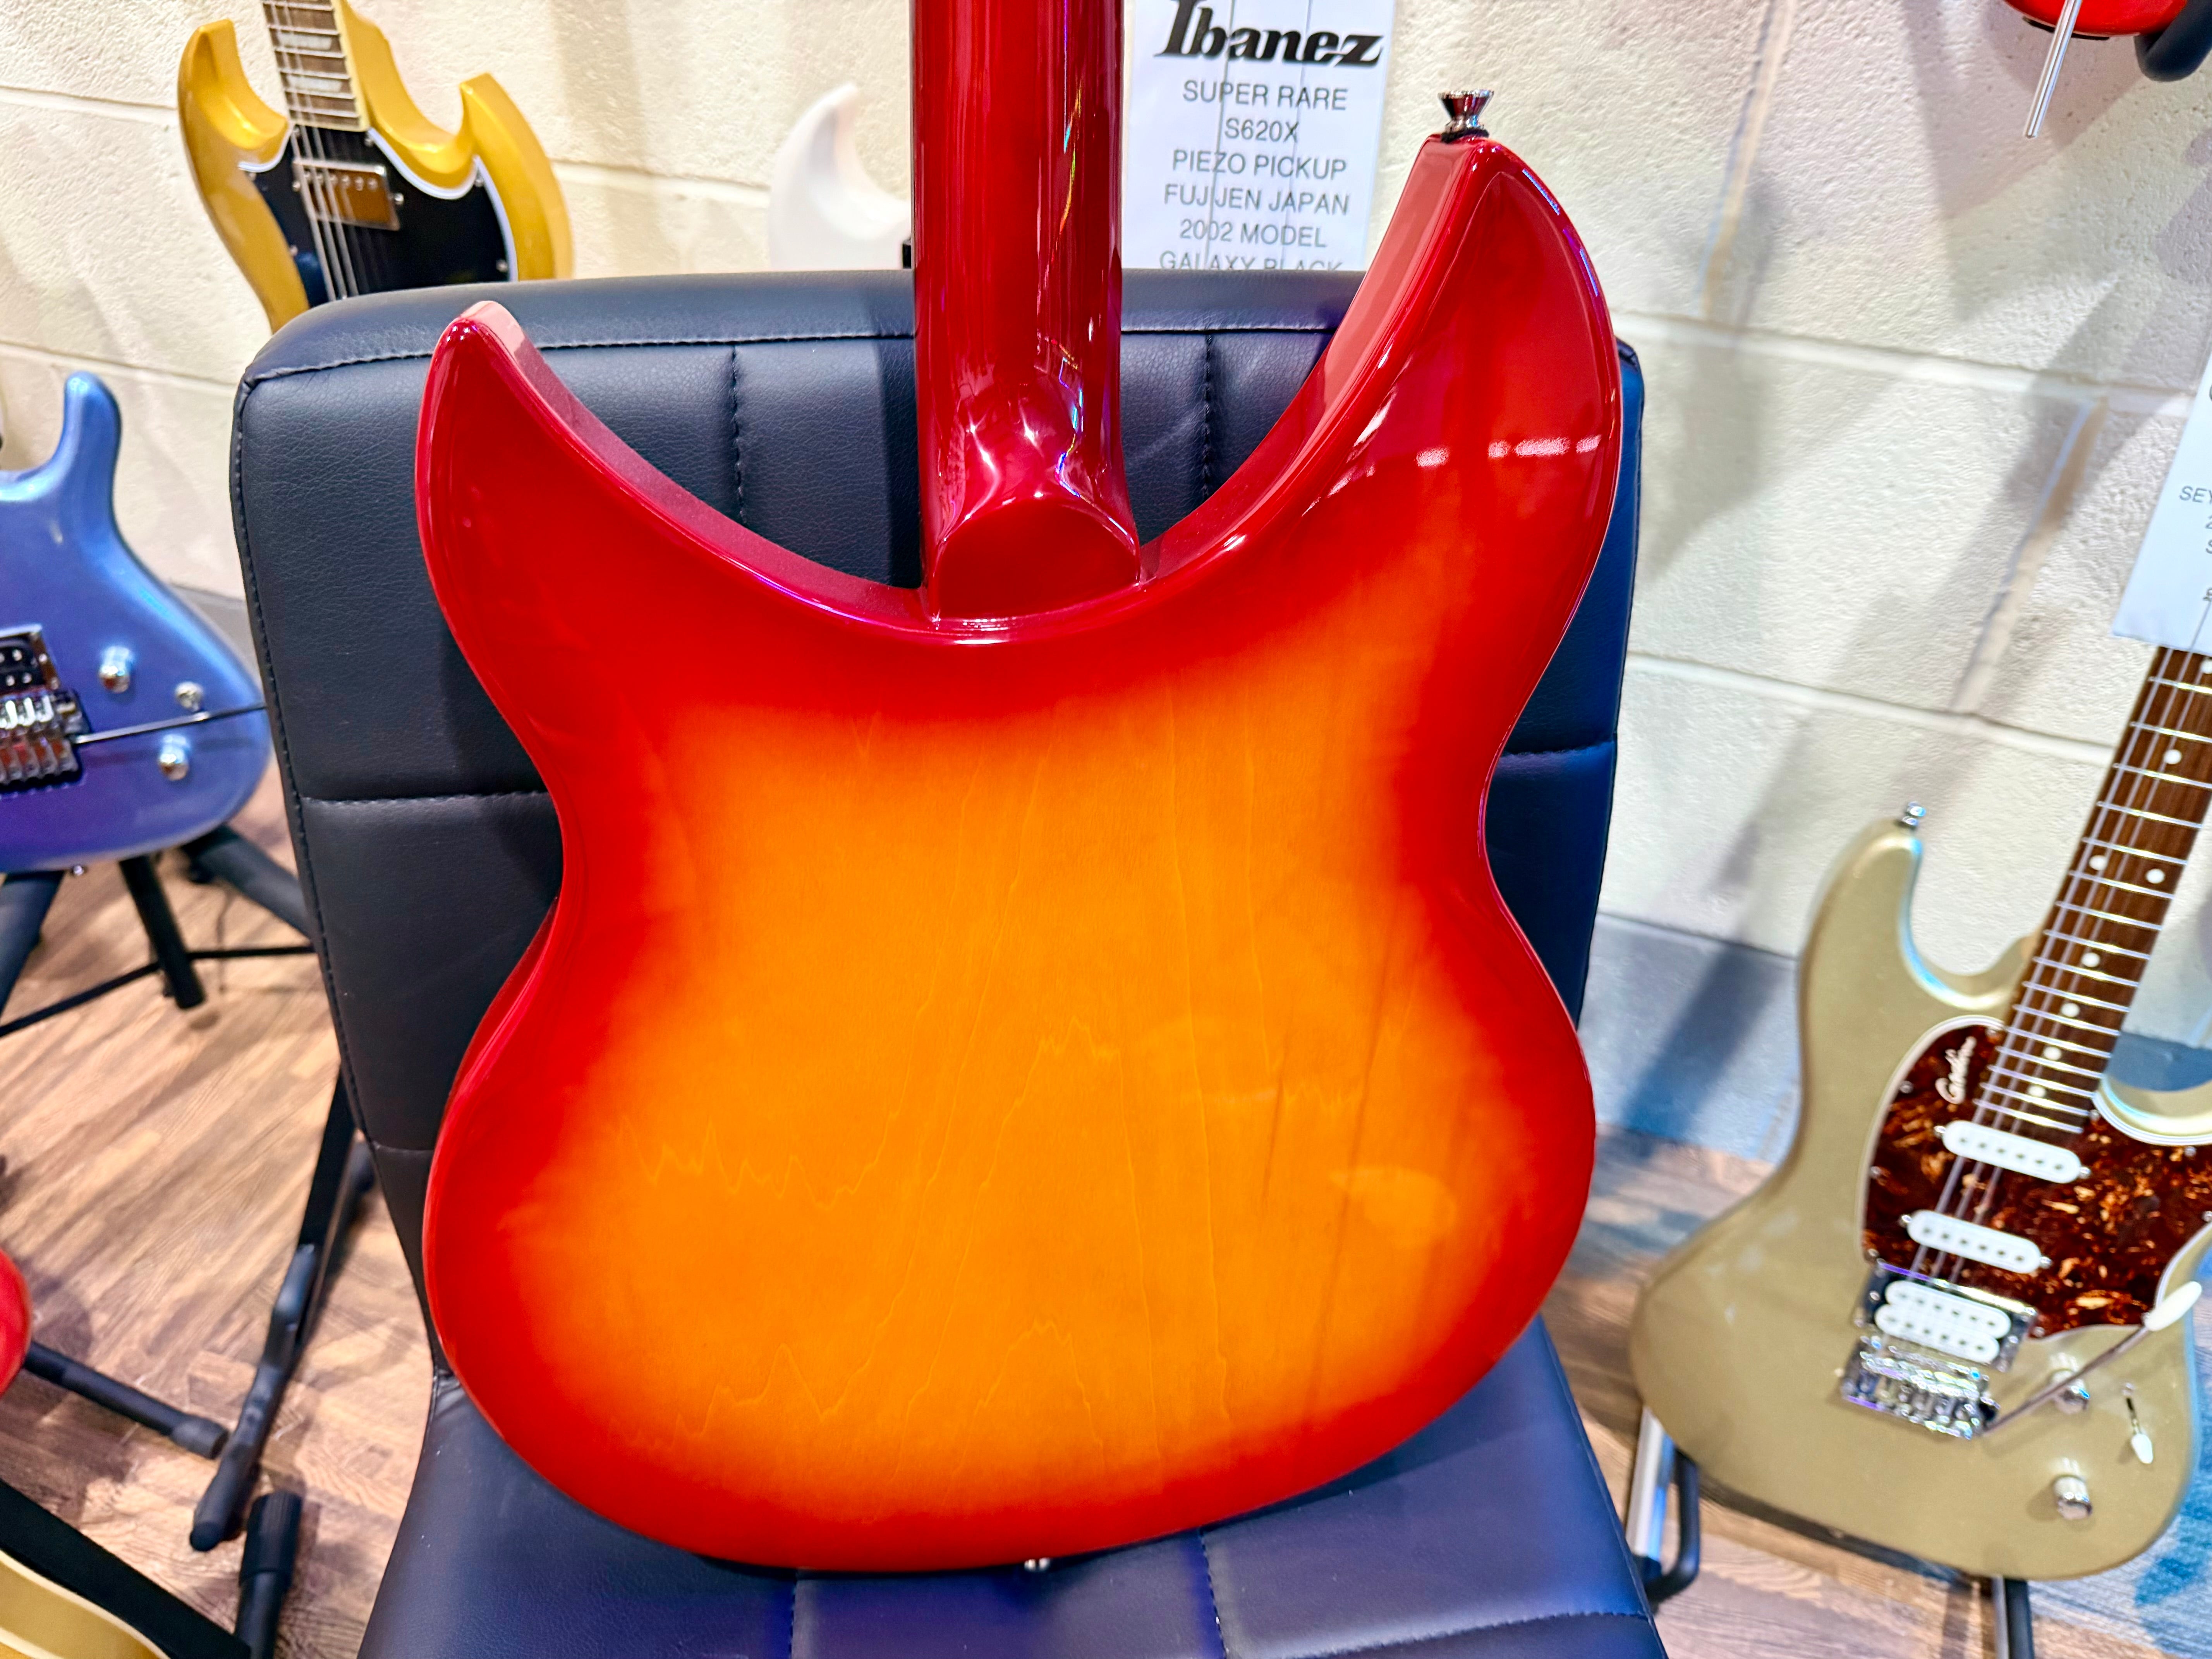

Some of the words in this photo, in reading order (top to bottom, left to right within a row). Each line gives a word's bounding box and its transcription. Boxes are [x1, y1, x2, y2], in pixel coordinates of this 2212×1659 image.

[1153, 0, 1384, 67] Ibanez
[1182, 80, 1268, 107] SUPER
[1278, 86, 1348, 110] RARE
[1224, 117, 1300, 143] S620X
[1173, 149, 1246, 174] PIEZO
[1254, 155, 1346, 180] PICKUP
[1269, 192, 1350, 215] JAPAN
[1180, 218, 1233, 242] 2002
[1240, 223, 1327, 247] MODEL
